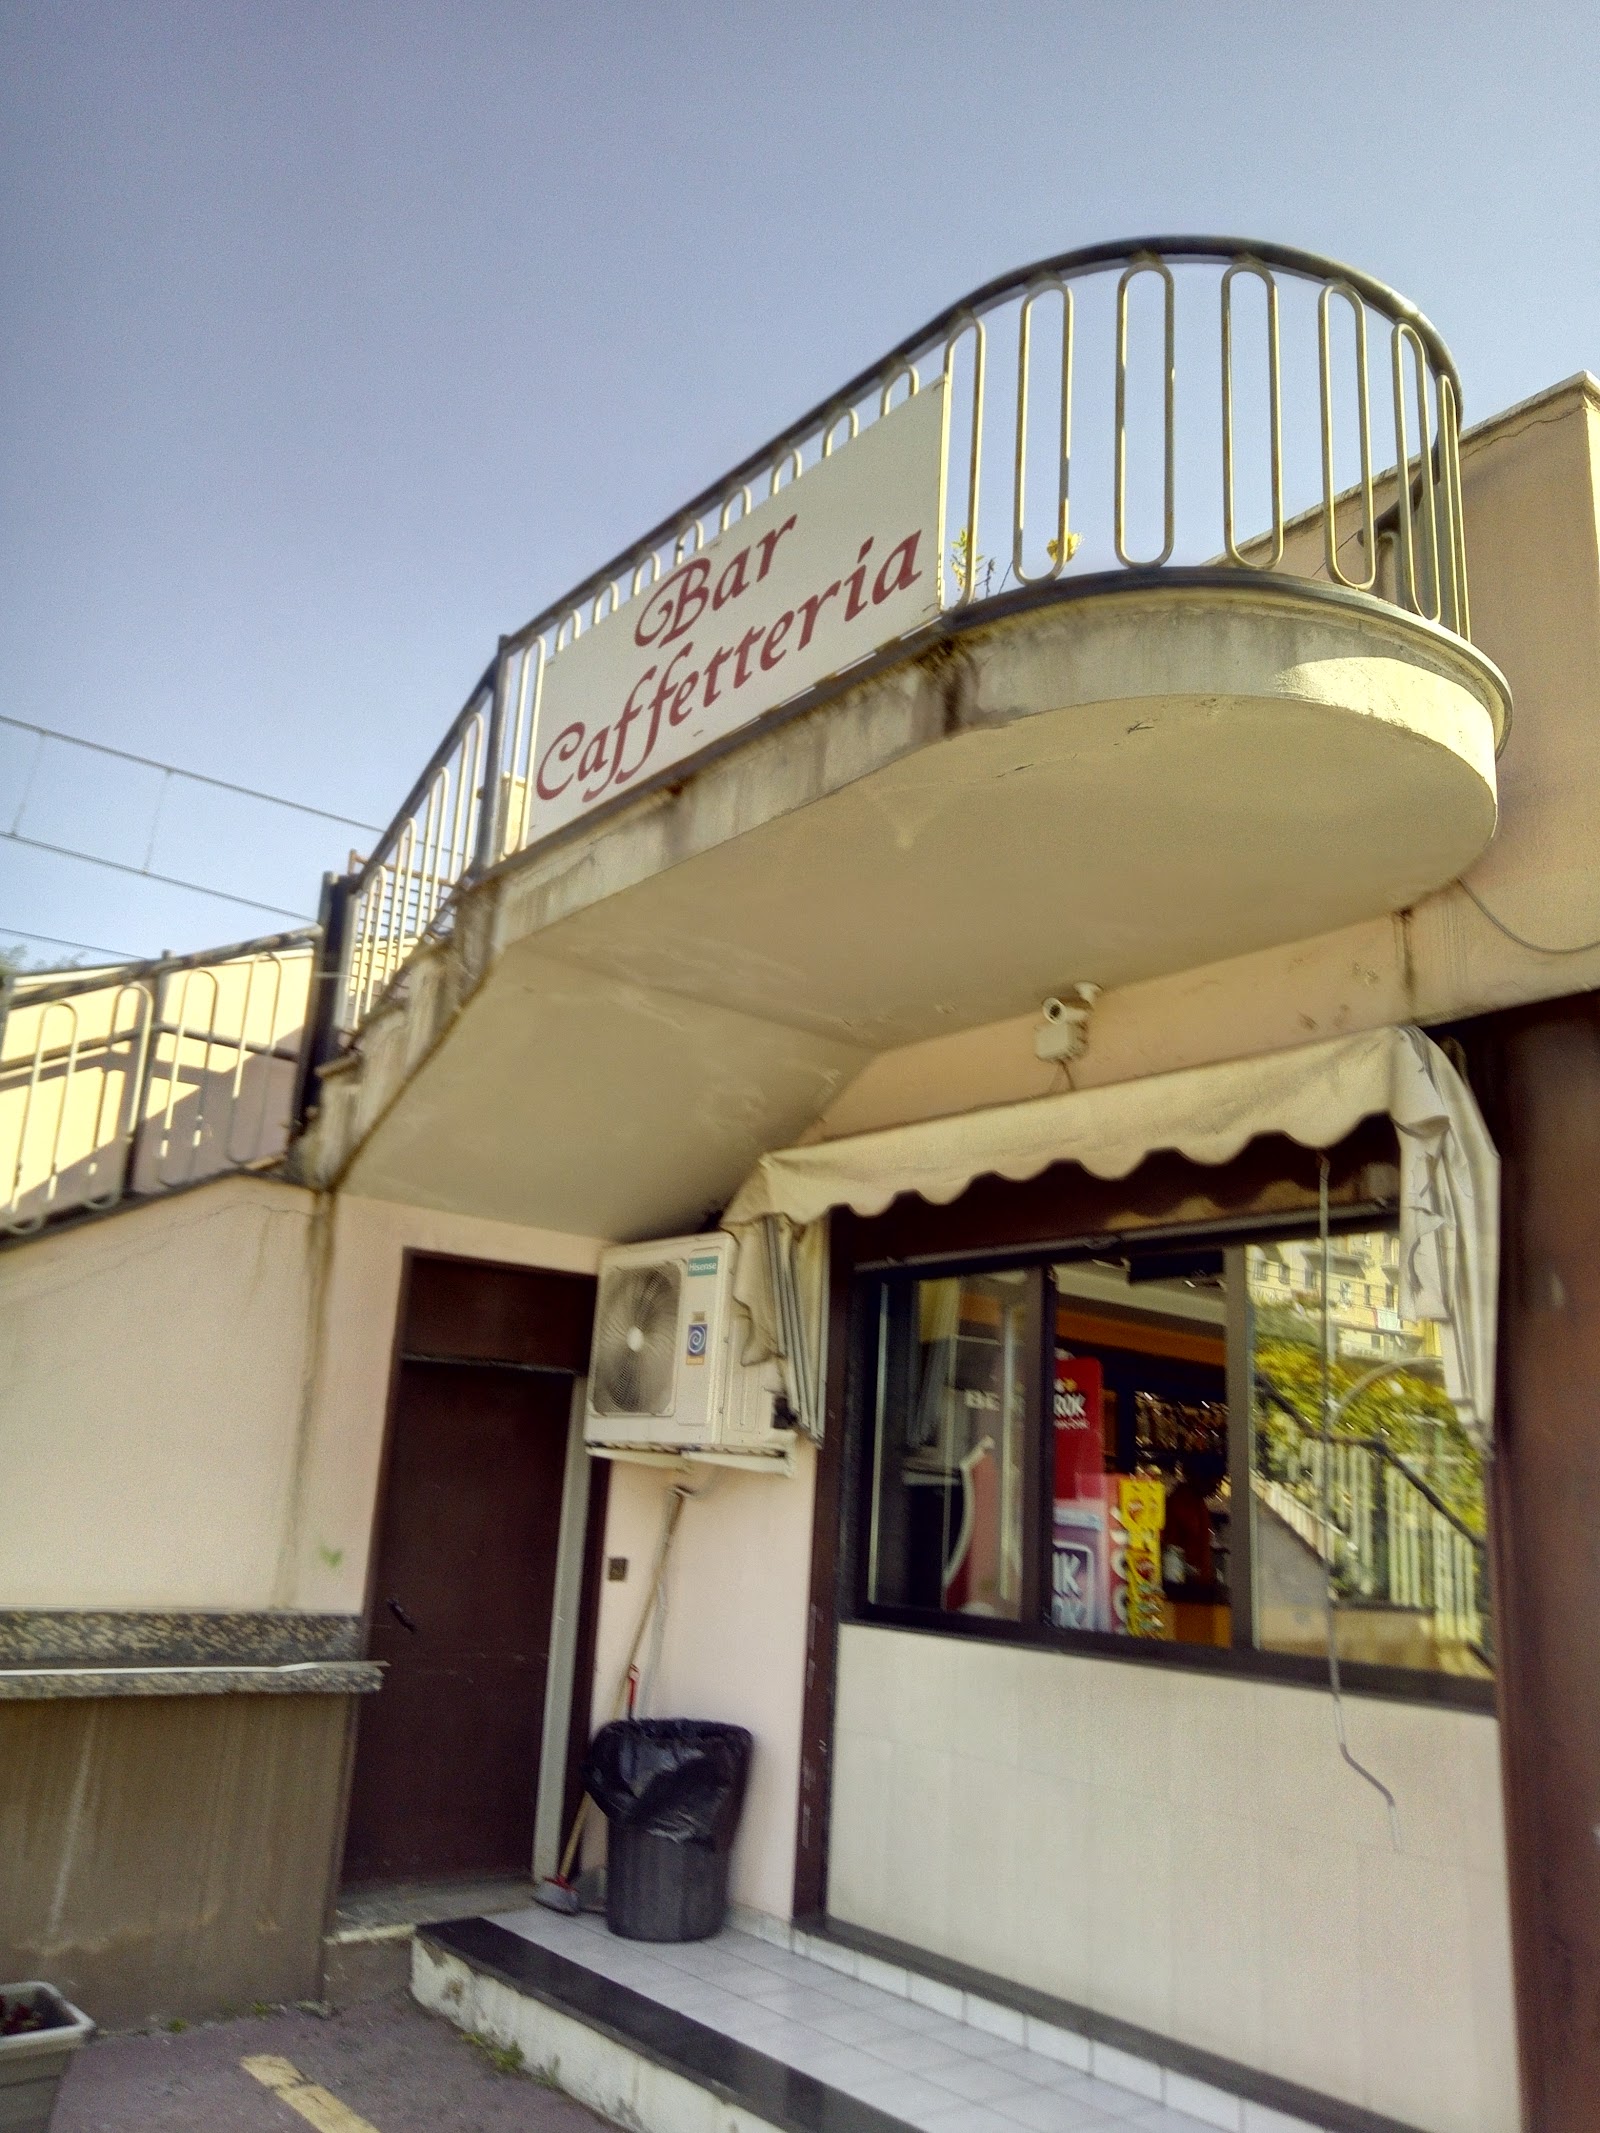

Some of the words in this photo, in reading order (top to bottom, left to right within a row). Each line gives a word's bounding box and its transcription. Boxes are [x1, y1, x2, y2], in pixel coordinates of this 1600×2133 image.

[634, 513, 798, 648] Bar
[536, 529, 923, 803] Caffetteria
[688, 1262, 717, 1271] Hisense
